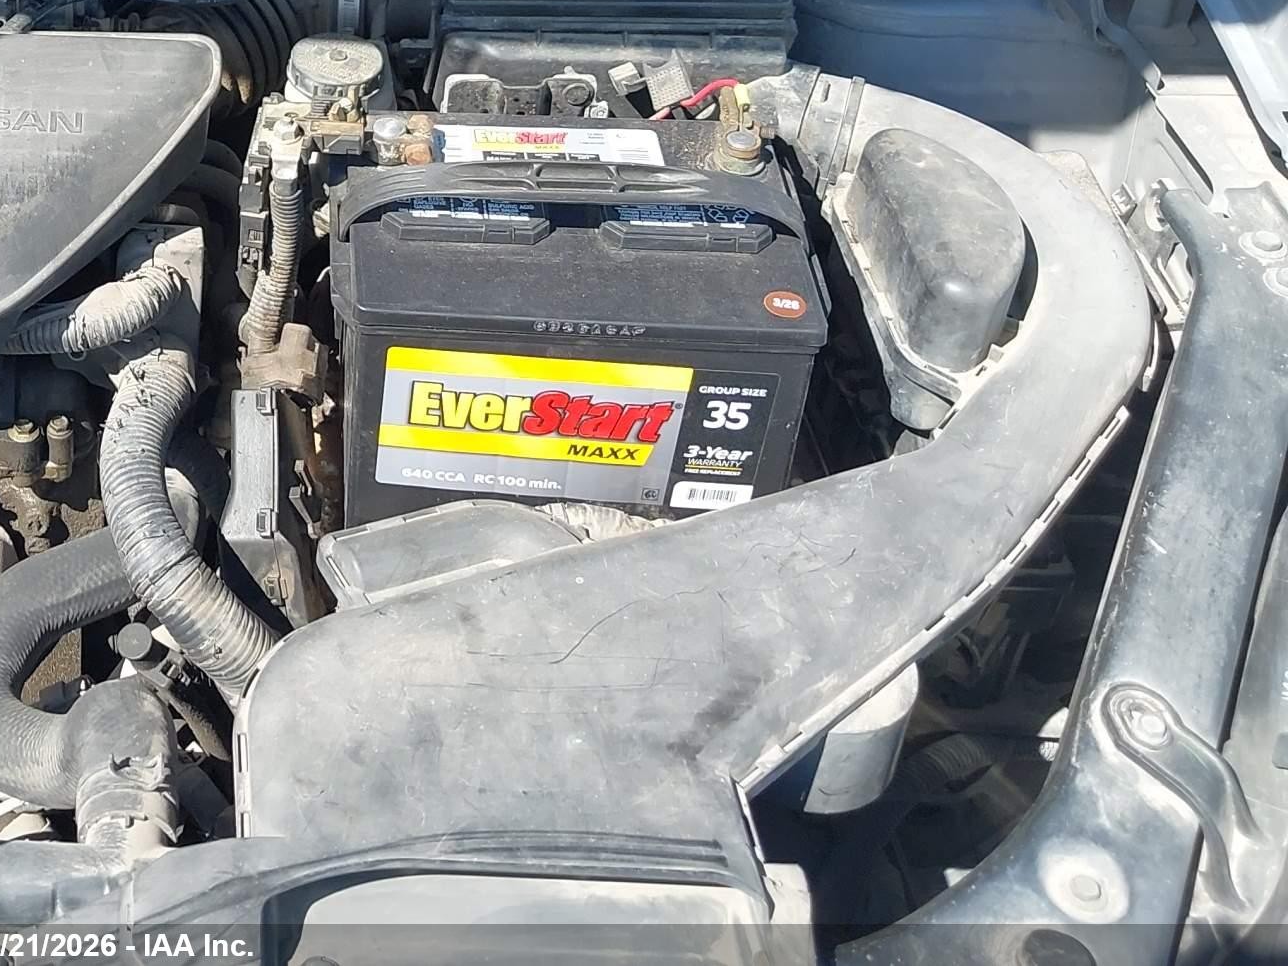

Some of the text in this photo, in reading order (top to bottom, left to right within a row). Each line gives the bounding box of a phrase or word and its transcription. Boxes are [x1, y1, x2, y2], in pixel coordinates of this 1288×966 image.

[699, 385, 768, 397] GROUP SIZE
[408, 380, 675, 443] EverStart
[702, 400, 752, 430] 35
[567, 443, 641, 461] MAXX
[683, 445, 753, 461] 3-Year
[687, 458, 743, 468] WARRANTY
[401, 467, 562, 490] 640 CCA RC 100 min.
